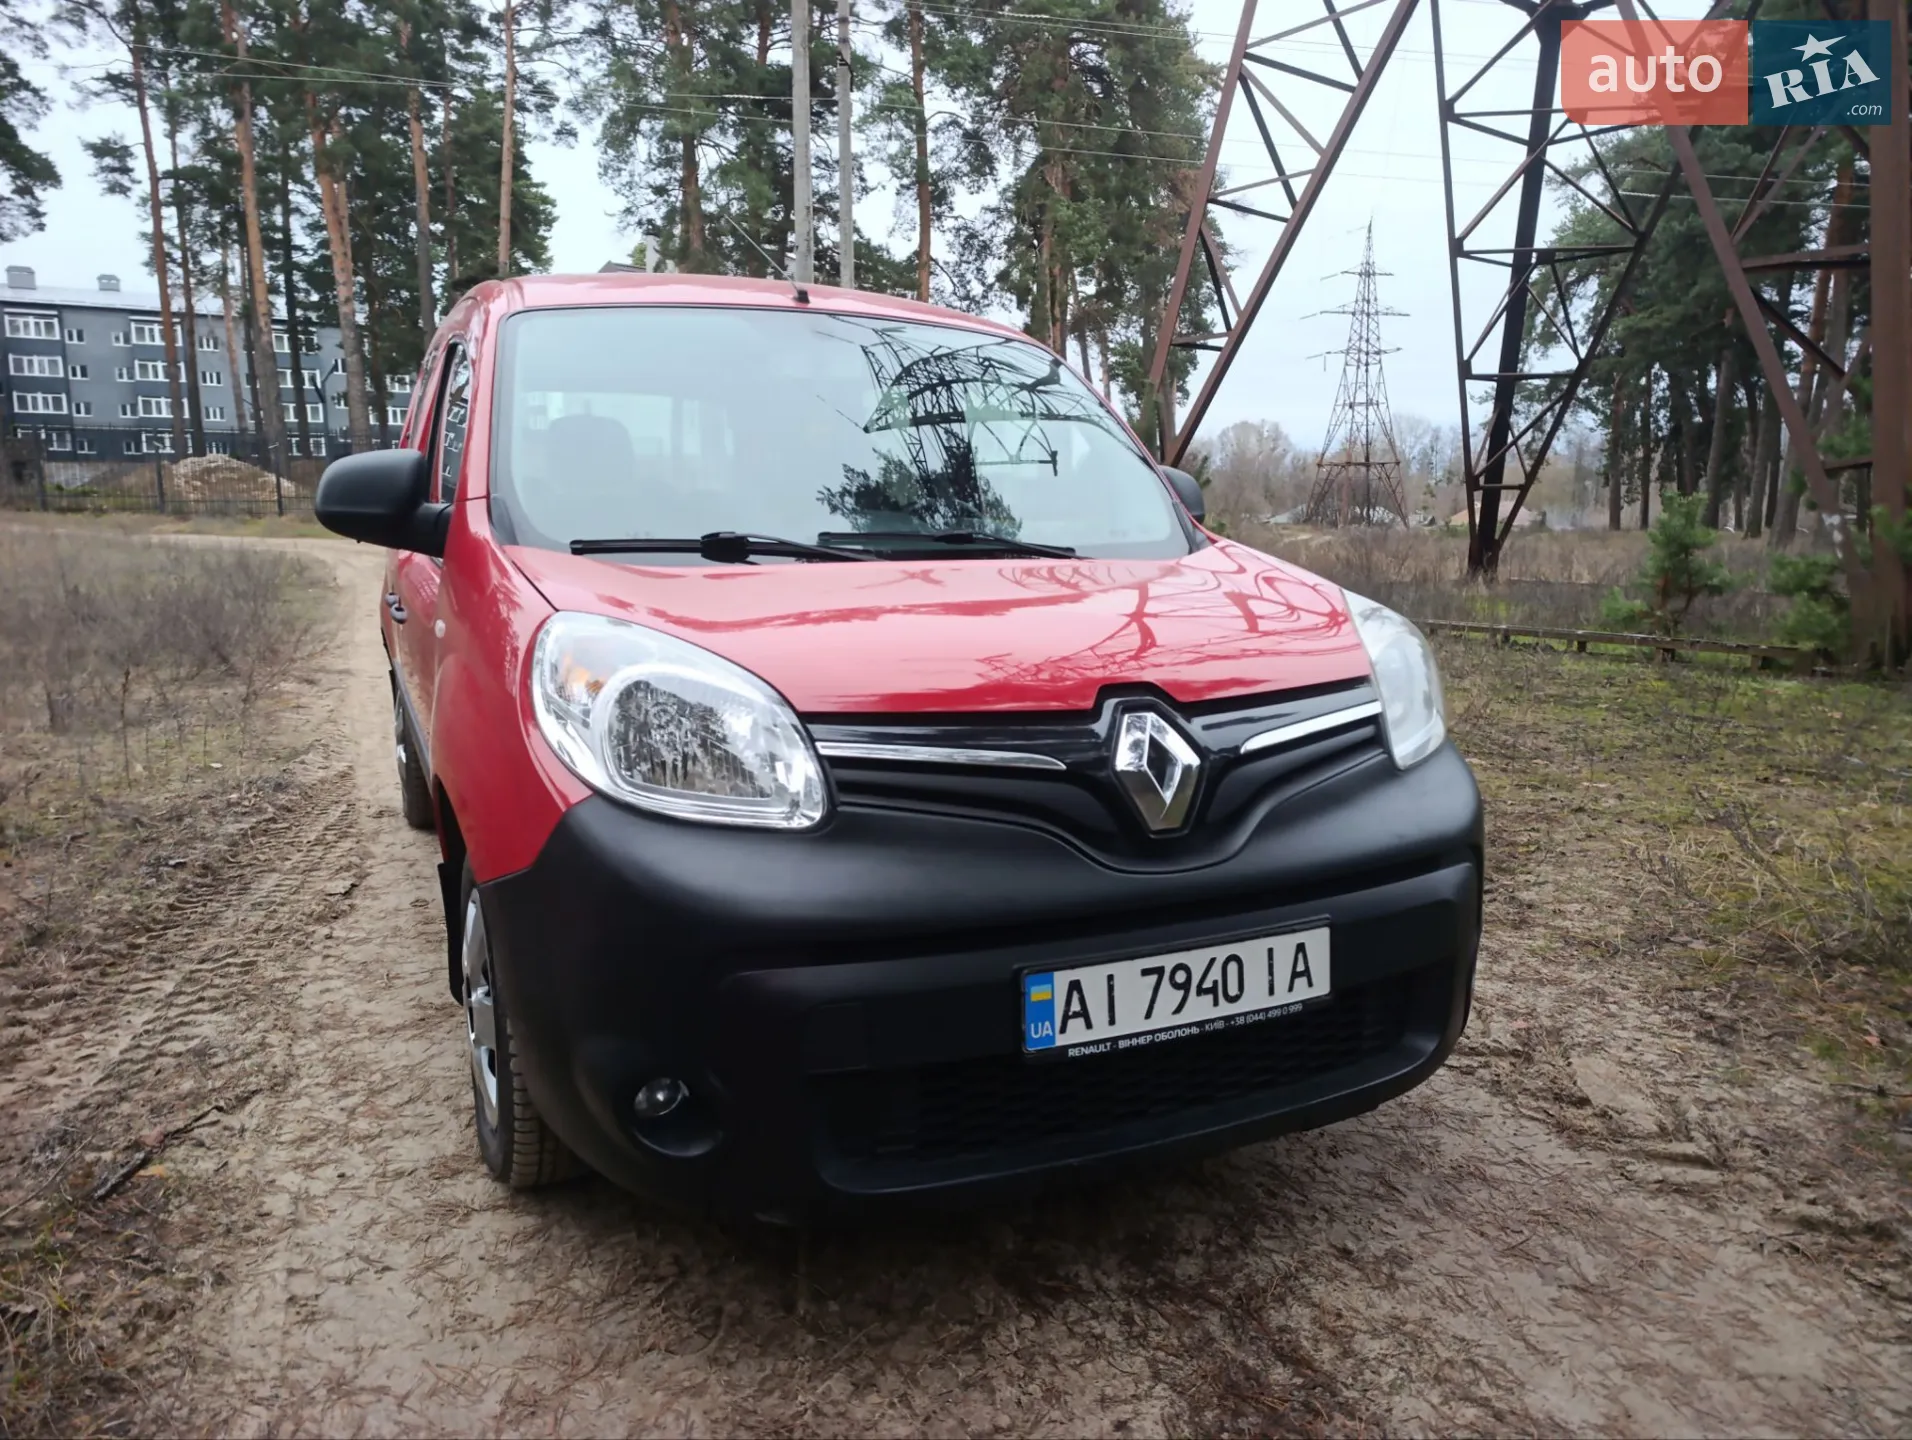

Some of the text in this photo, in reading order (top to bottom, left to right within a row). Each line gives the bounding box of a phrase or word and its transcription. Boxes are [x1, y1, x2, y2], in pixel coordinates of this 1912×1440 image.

[1059, 942, 1314, 1034] AI 7940 IA
[1030, 1020, 1053, 1039] UA
[1068, 1042, 1112, 1057] RENAULT
[1118, 1035, 1153, 1049] ВІННЕР
[1154, 1026, 1200, 1042] ОБОЛОНЬ
[1230, 1016, 1245, 1026] +38
[1246, 1011, 1266, 1023] (044)
